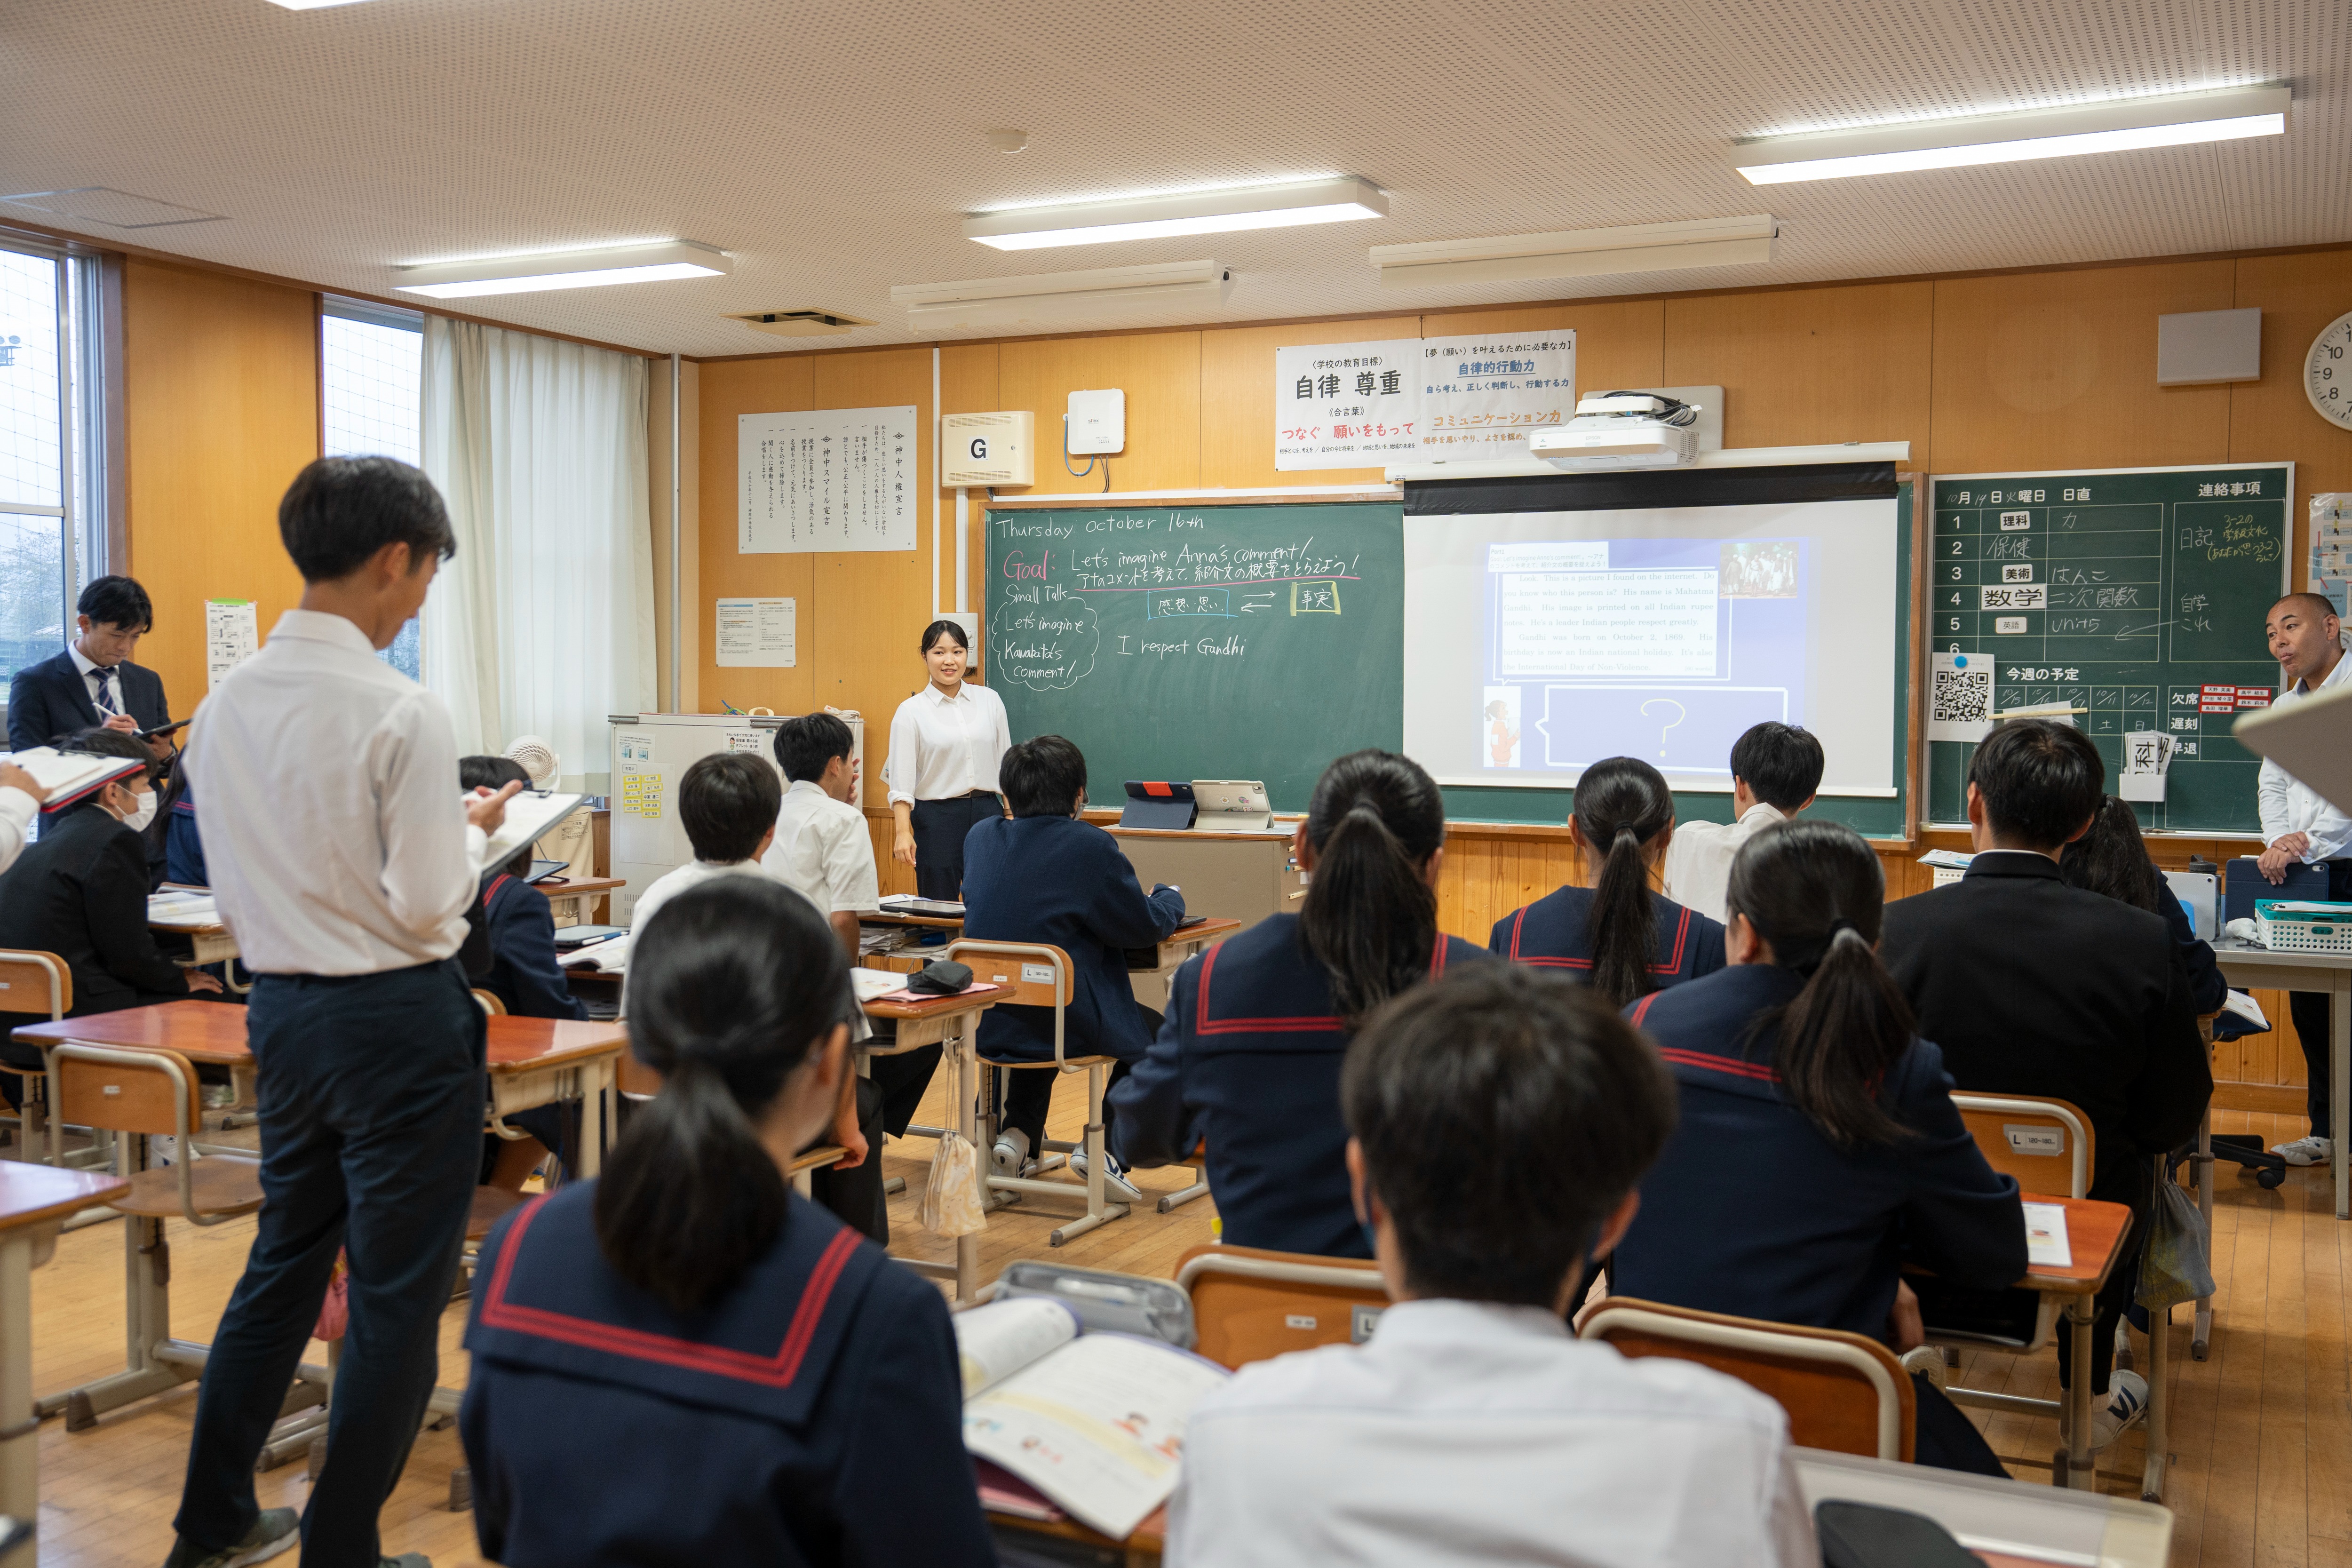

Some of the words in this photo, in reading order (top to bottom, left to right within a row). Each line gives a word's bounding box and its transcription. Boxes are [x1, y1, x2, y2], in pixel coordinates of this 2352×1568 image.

[1425, 341, 1571, 358] 【夢（願い）を叶えるために必要な力】
[2328, 347, 2343, 359] 10
[1459, 359, 1534, 375] 自律的行動力
[2323, 368, 2332, 380] 9
[1297, 374, 1341, 399] 自律
[1355, 370, 1401, 396] 尊重
[1426, 379, 1569, 393] 自ら考え、正しく判断し、行動する力
[2329, 387, 2338, 399] 8
[1434, 410, 1561, 426] コミュニケーション力
[1282, 427, 1320, 440] つなぐ
[1334, 423, 1414, 438] 願いをもって
[970, 438, 986, 459] G
[2064, 487, 2091, 501] 日直
[2198, 481, 2261, 496] 連絡事項
[996, 517, 1074, 539] Thursday
[1169, 513, 1204, 532] 16th
[1953, 516, 1960, 529] 1
[2003, 515, 2027, 526] 理科
[2181, 526, 2213, 550] 日記
[1952, 541, 1962, 555] 2
[1986, 535, 2032, 559] 保健
[1072, 548, 1109, 571] Let's
[1118, 549, 1167, 572] imagine
[1176, 543, 1228, 566] Anna's
[1578, 573, 1604, 582] picture
[1951, 567, 1962, 580] 3
[2005, 568, 2030, 580] 美術
[2052, 568, 2110, 584] はんこ
[1006, 584, 1039, 605] Small
[1044, 583, 1068, 602] Talk
[1301, 589, 1333, 611] 事実
[1950, 592, 1962, 605] 4
[1984, 589, 2042, 607] 数学
[1006, 612, 1035, 631] Let's
[1039, 617, 1084, 636] imagine
[1950, 617, 1961, 631] 5
[2002, 621, 2020, 630] 英語
[1117, 635, 1133, 655] I
[1141, 639, 1190, 660] respect
[1949, 643, 1960, 655] 6
[2006, 667, 2080, 682] 今週の予定
[2171, 692, 2199, 705] 欠席
[2098, 720, 2112, 729] 土
[2135, 720, 2145, 732] 日
[2170, 717, 2198, 730] 遅刻
[2174, 742, 2197, 755] 早退
[2135, 741, 2155, 775] 科
[2014, 1135, 2020, 1144] L
